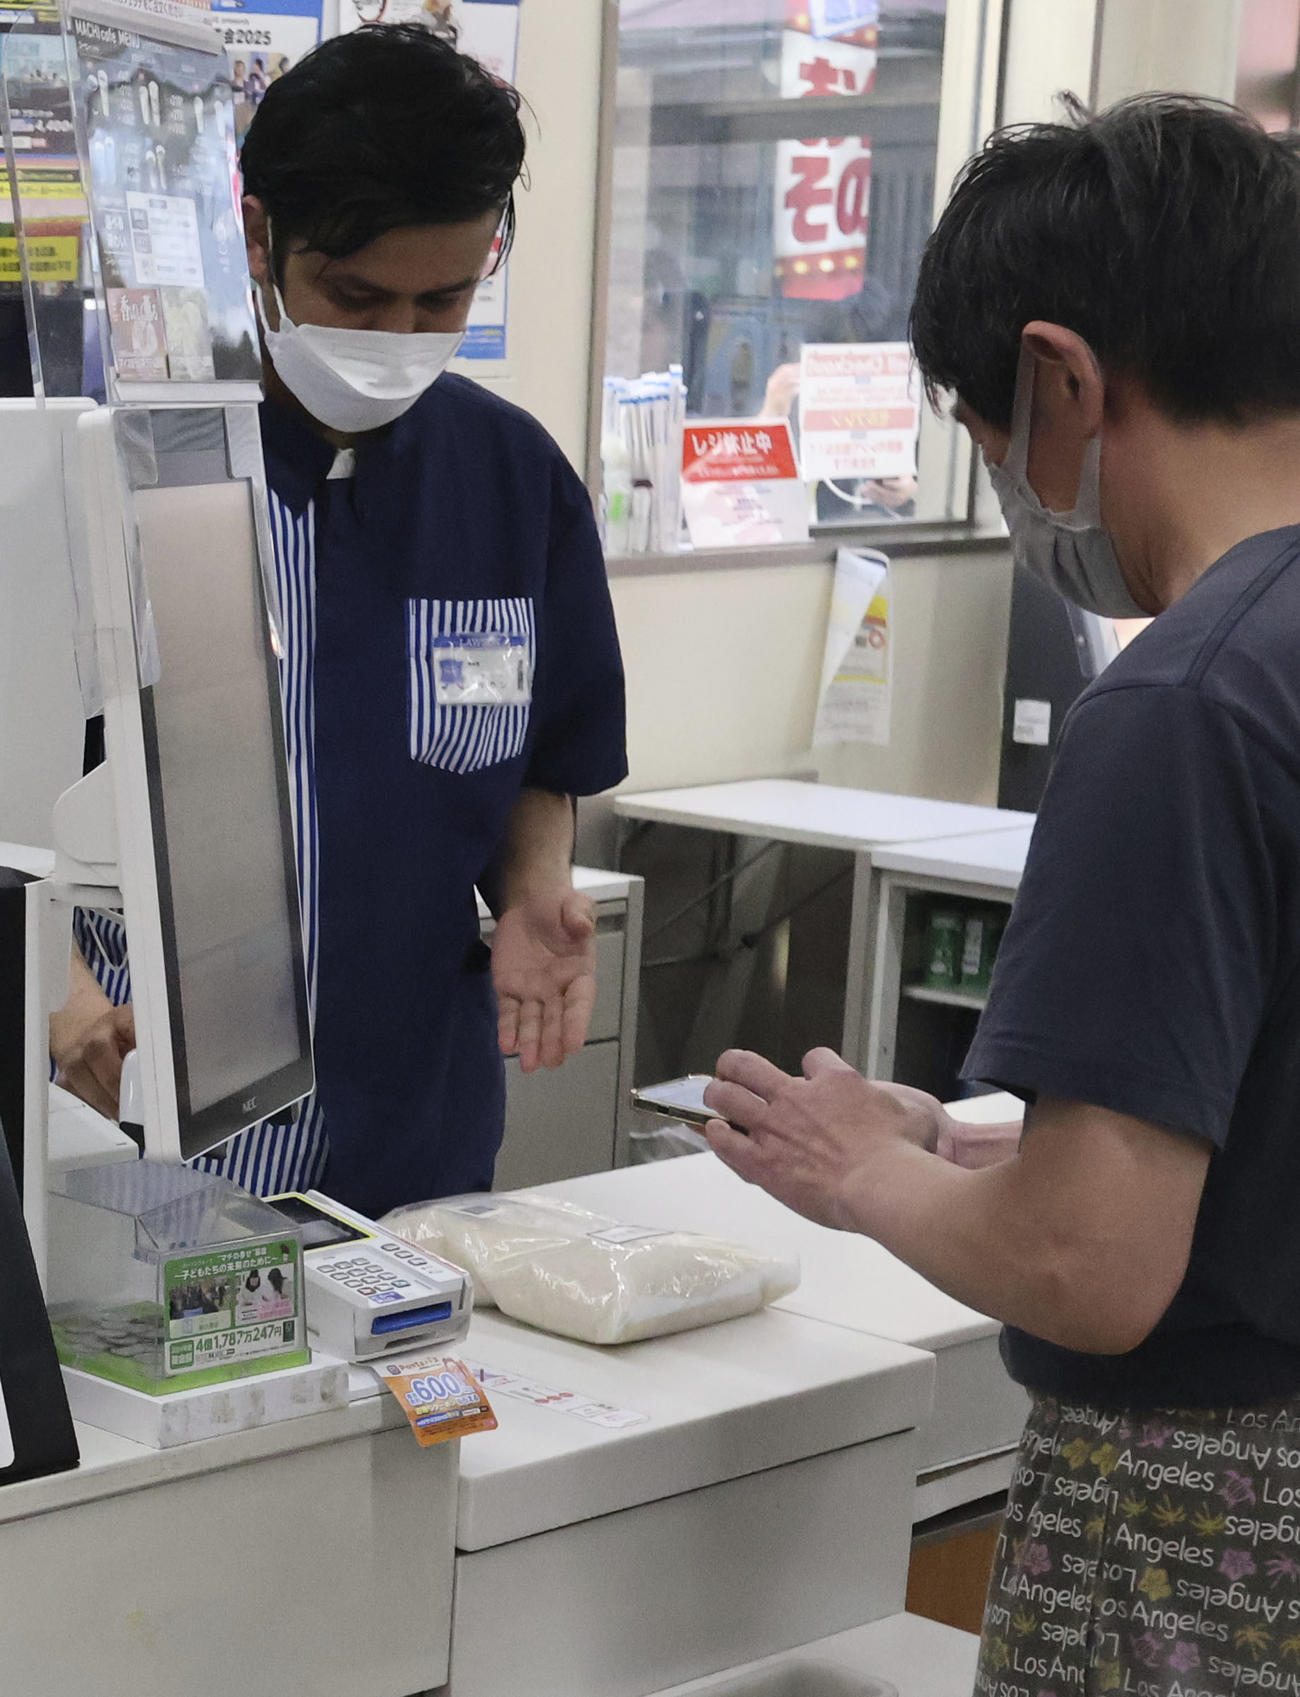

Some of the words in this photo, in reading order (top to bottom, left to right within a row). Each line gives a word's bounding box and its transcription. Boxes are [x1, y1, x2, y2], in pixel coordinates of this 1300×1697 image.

[692, 430, 773, 456] レジ休止中
[412, 1373, 461, 1402] 600
[1114, 1449, 1215, 1492] Angeles
[1172, 1430, 1271, 1470] Angeles
[1114, 1523, 1215, 1567] Angeles
[1130, 1600, 1229, 1642] Angeles
[1176, 1579, 1284, 1623] Angeles
[1013, 1647, 1047, 1677] Los
